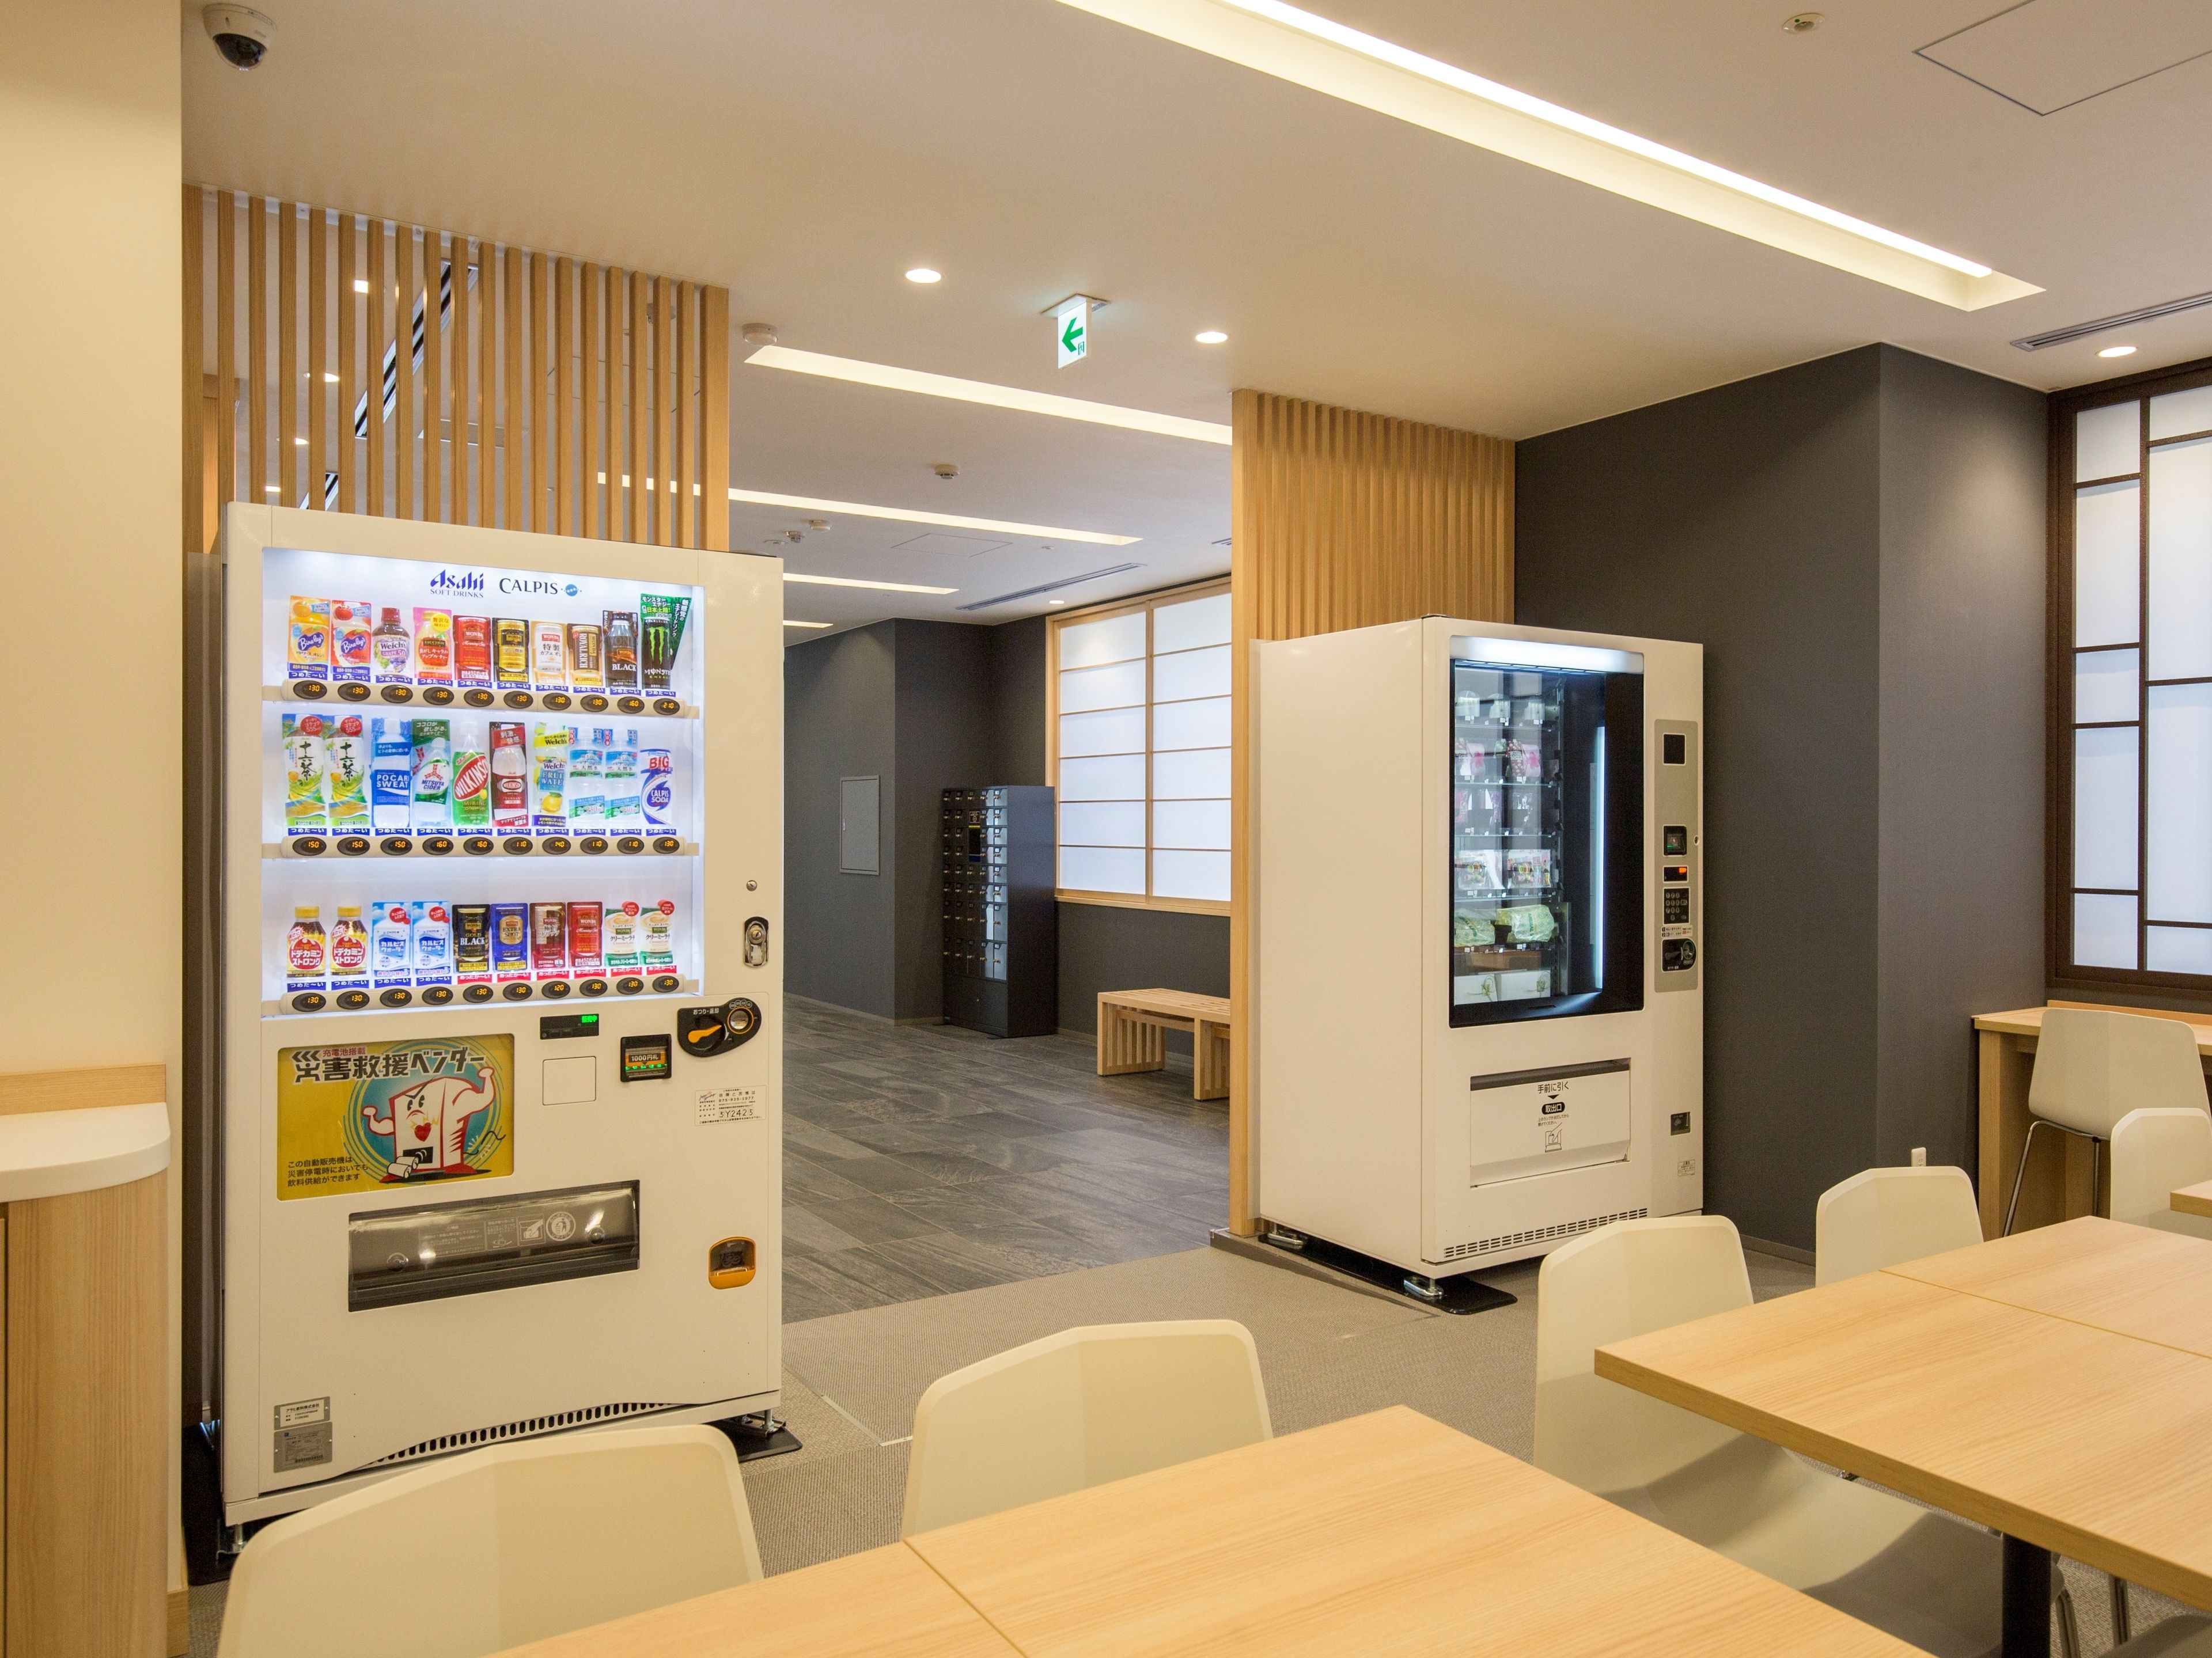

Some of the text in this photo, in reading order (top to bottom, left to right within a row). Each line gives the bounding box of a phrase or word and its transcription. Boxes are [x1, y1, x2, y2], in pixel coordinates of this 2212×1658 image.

[430, 568, 484, 591] Asahi
[499, 578, 558, 594] CALPIS
[430, 588, 484, 598] SOFT DRINKS
[542, 643, 560, 652] 特製
[612, 663, 637, 671] BLACK
[298, 741, 318, 781] 十六茶
[339, 742, 359, 781] 十六茶
[649, 756, 670, 769] BIG
[460, 937, 485, 946] BLACK
[291, 950, 323, 958] ドデカミン
[334, 948, 363, 956] ドデカミン
[323, 1047, 366, 1058] 充電池搭載
[631, 1053, 659, 1062] 1000円札
[291, 1047, 484, 1083] 災害救援ベンダー
[1537, 1080, 1569, 1094] 手前に引く
[1545, 1103, 1562, 1114] 取出口
[288, 1156, 353, 1169] この自動販売機は
[288, 1163, 369, 1178] 災害停電時においても
[287, 1173, 361, 1187] 飲料供給ができます
